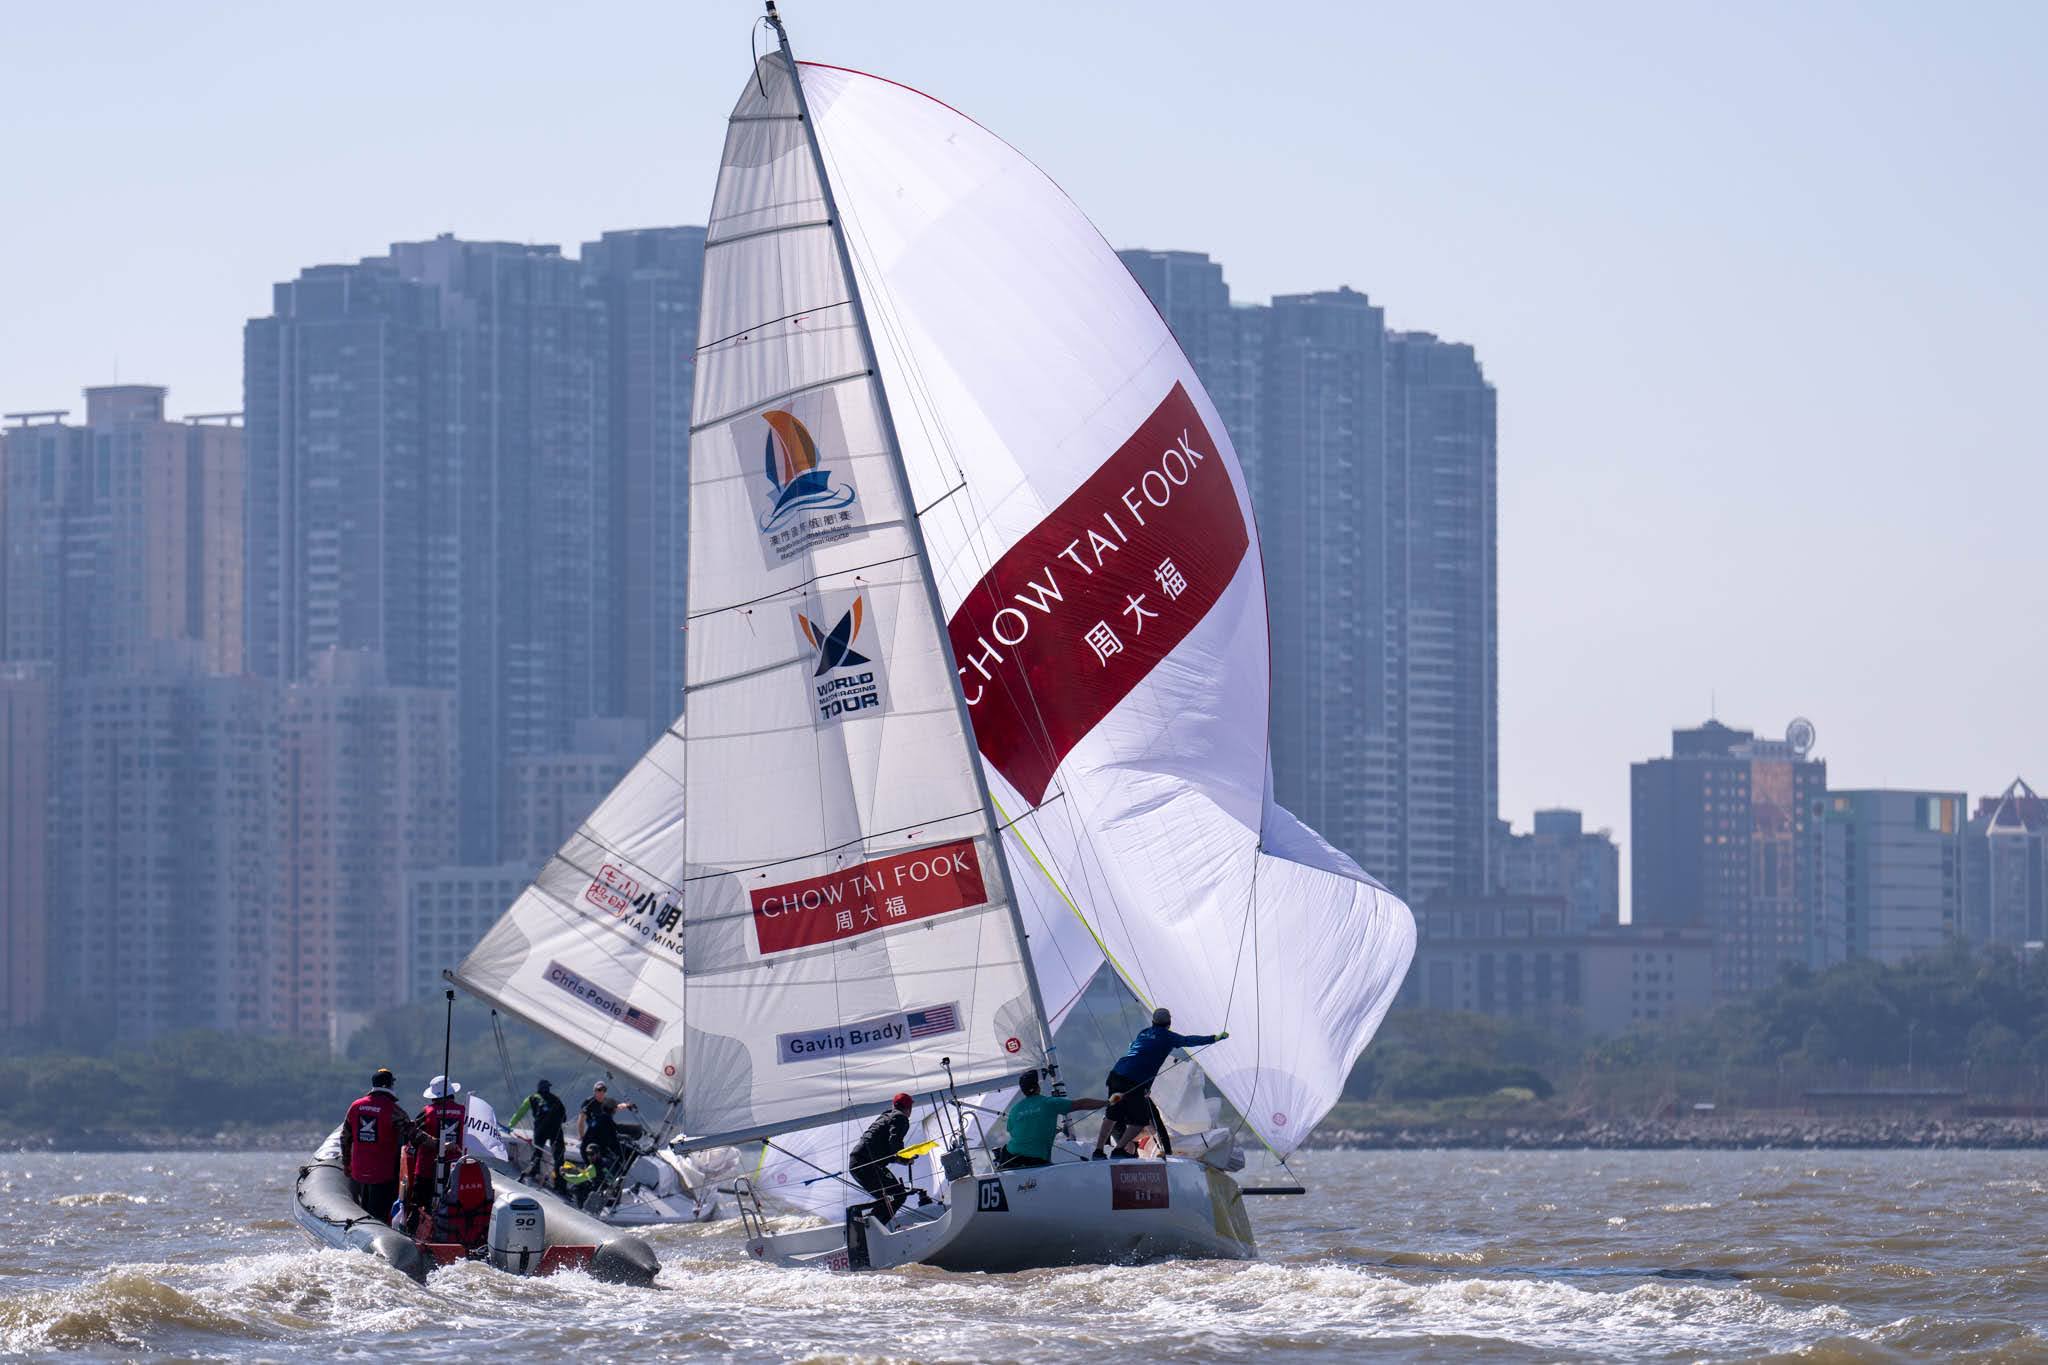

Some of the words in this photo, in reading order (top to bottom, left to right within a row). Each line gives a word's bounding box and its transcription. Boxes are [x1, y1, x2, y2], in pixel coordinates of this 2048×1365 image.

[958, 566, 1064, 706] CHOW
[1058, 511, 1128, 575] TAI
[1121, 428, 1204, 527] FOOK
[1083, 557, 1188, 668] 周大福
[816, 672, 874, 697] WORLD
[839, 684, 877, 697] RACING
[820, 692, 880, 720] TOUR
[761, 881, 845, 918] CHOW
[849, 870, 886, 897] TAI
[894, 851, 971, 887] FOOK
[835, 895, 908, 933] 周大福
[622, 913, 651, 936] XIAO
[650, 931, 683, 955] MING
[551, 968, 584, 995] Chris
[586, 989, 622, 1017] Poole
[790, 1033, 845, 1054] Gavin
[850, 1022, 905, 1046] Brady
[981, 1182, 1000, 1209] 05
[515, 1218, 536, 1227] 90
